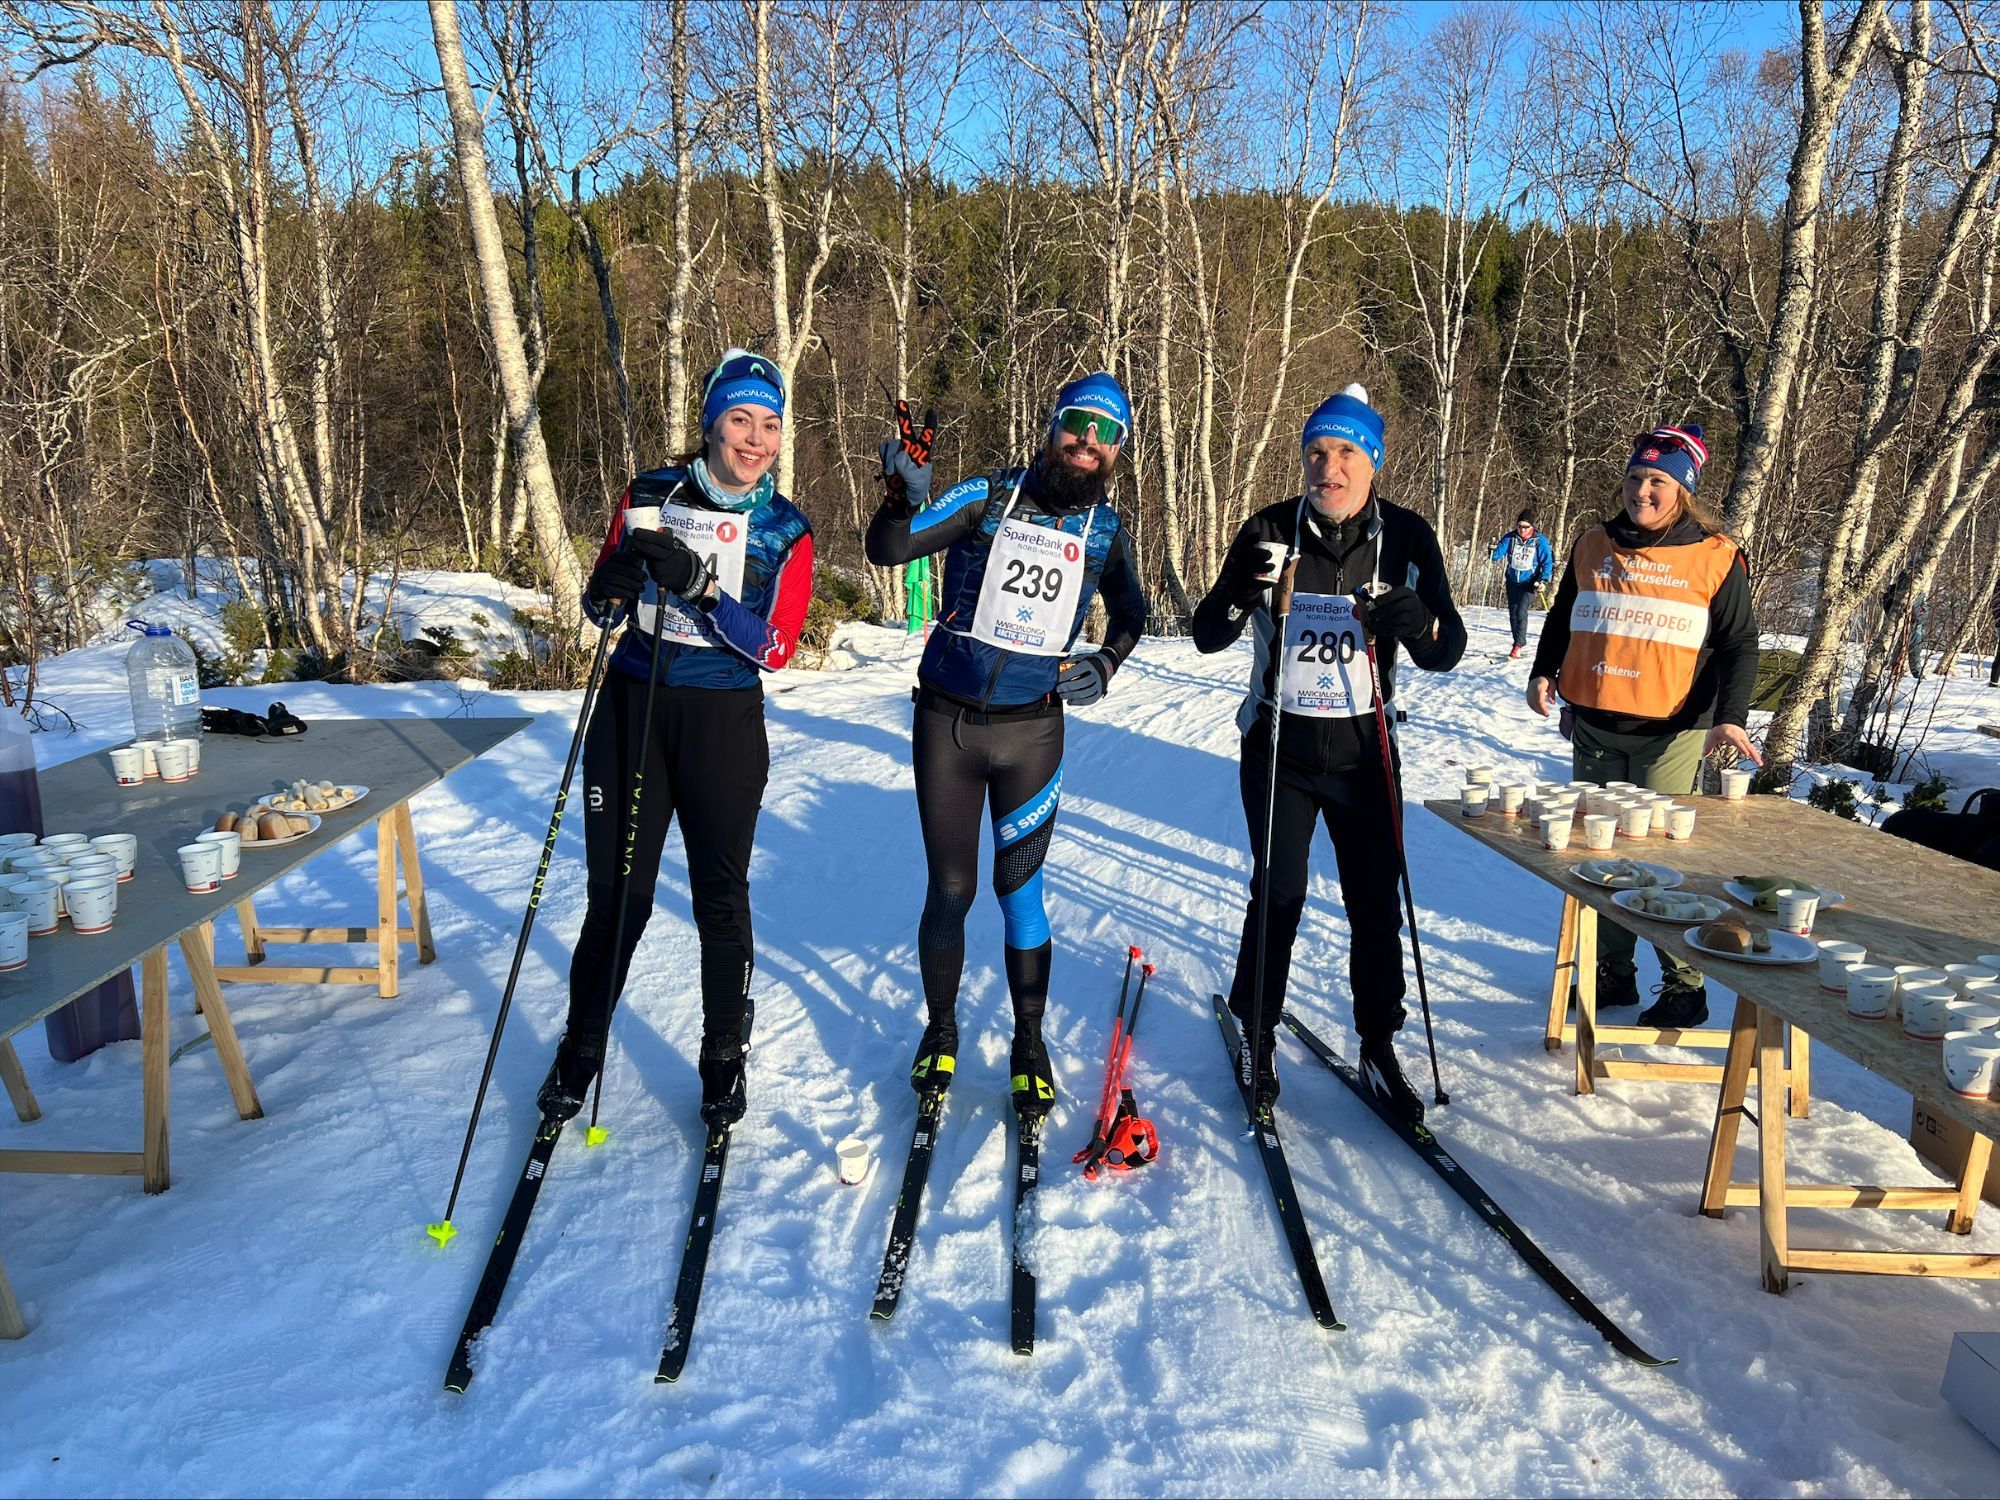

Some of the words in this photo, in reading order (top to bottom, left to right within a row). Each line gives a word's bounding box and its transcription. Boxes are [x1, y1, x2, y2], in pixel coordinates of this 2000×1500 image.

[727, 389, 778, 405] MARCIALONGA
[1074, 394, 1121, 414] MARCIALONGA
[1305, 424, 1355, 436] MARCIALONGA
[659, 511, 715, 532] SpareBank
[1003, 526, 1063, 551] SpareBank
[1017, 543, 1062, 559] NORD-NORGE
[1622, 555, 1672, 573] Telenor
[1001, 559, 1063, 602] 239
[1620, 570, 1689, 589] Karusellen
[1291, 600, 1350, 614] SpareBank
[1592, 606, 1654, 626] HJELPER
[1657, 614, 1692, 633] DEG!
[996, 620, 1046, 637] MARCIALONGA
[996, 629, 1018, 640] ARCTIC
[1297, 630, 1356, 664] 280
[1604, 664, 1641, 679] telenor
[1297, 690, 1350, 698] MARCIALONGA
[1300, 697, 1321, 706] ARCTIC
[1322, 698, 1332, 706] SKI
[1333, 699, 1348, 707] RACE
[1018, 769, 1063, 829] sportf
